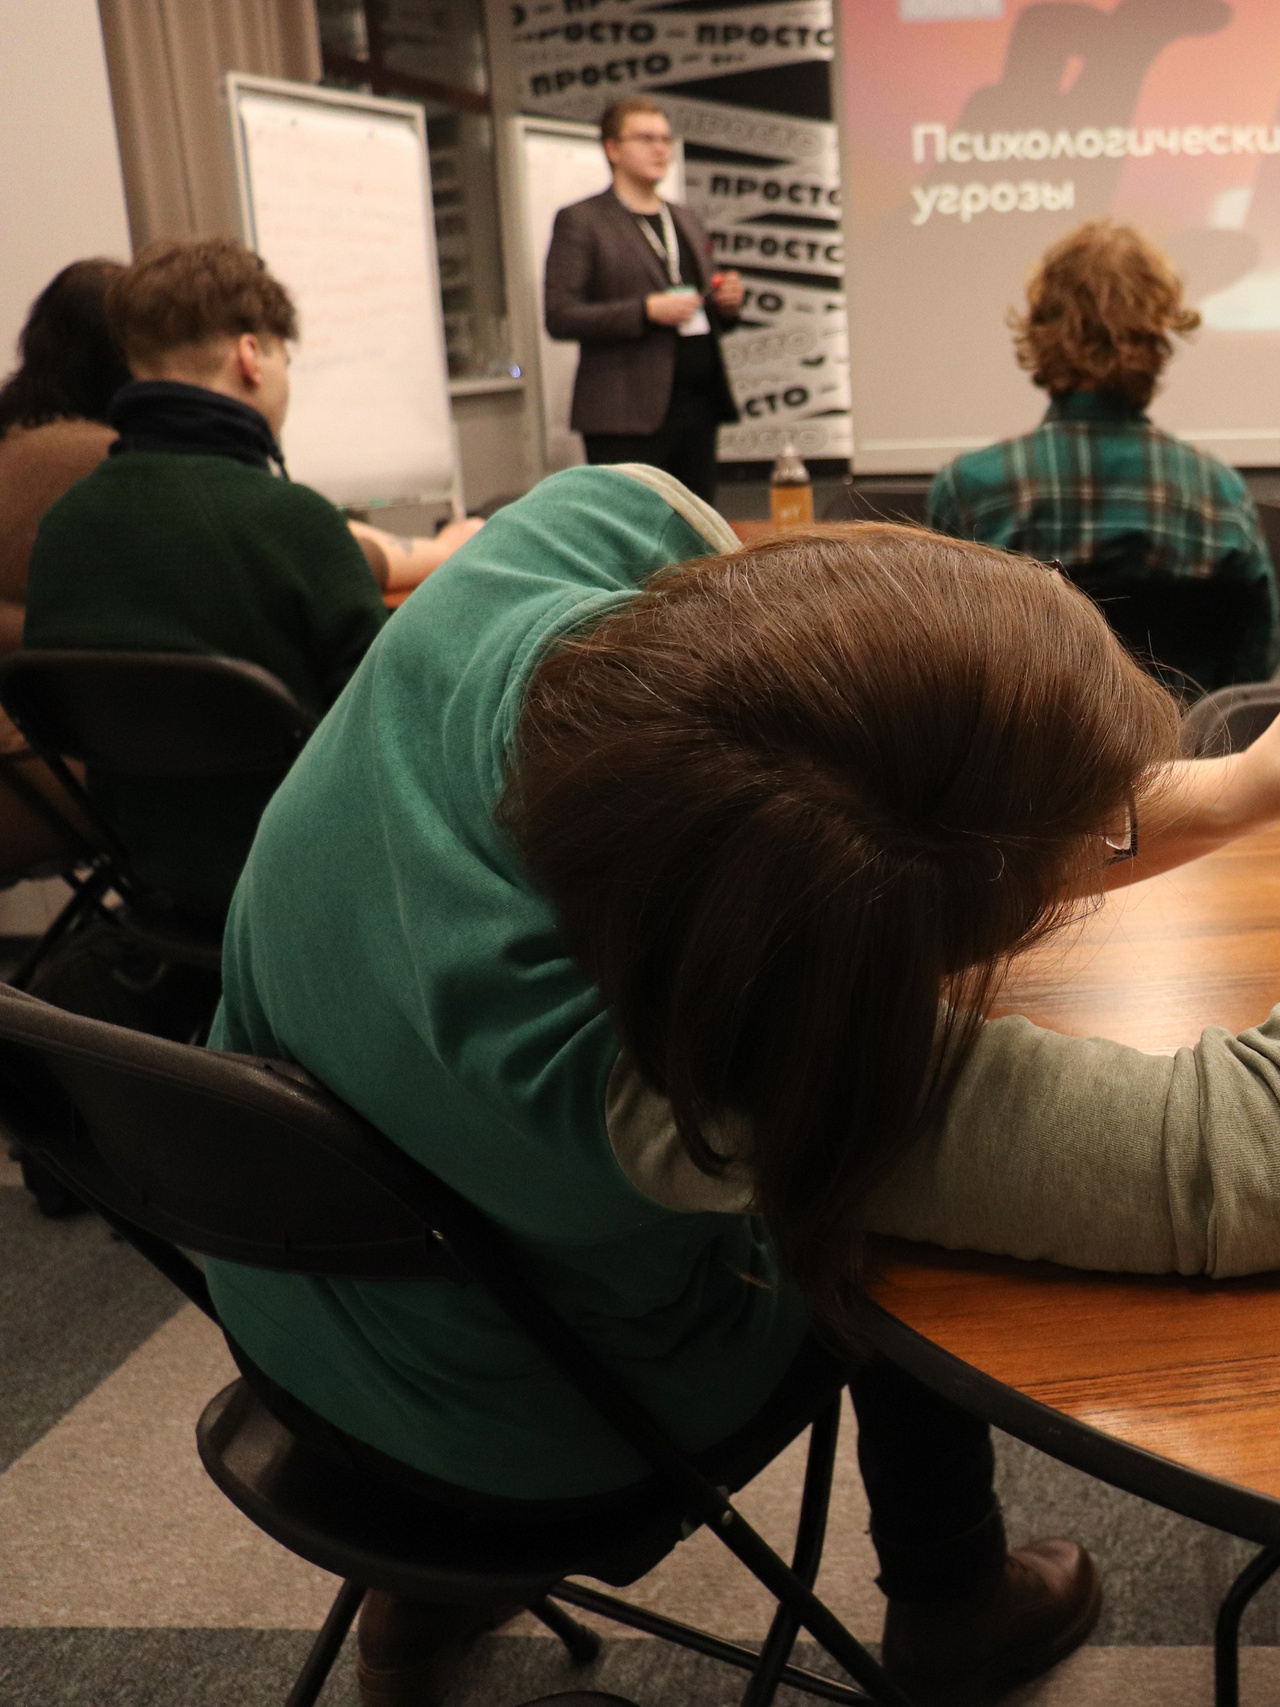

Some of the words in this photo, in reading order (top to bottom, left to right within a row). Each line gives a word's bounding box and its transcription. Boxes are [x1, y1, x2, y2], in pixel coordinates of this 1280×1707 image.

[530, 52, 672, 97] ПРОСТО
[910, 180, 1076, 226] угрозы
[745, 386, 809, 418] СТО
